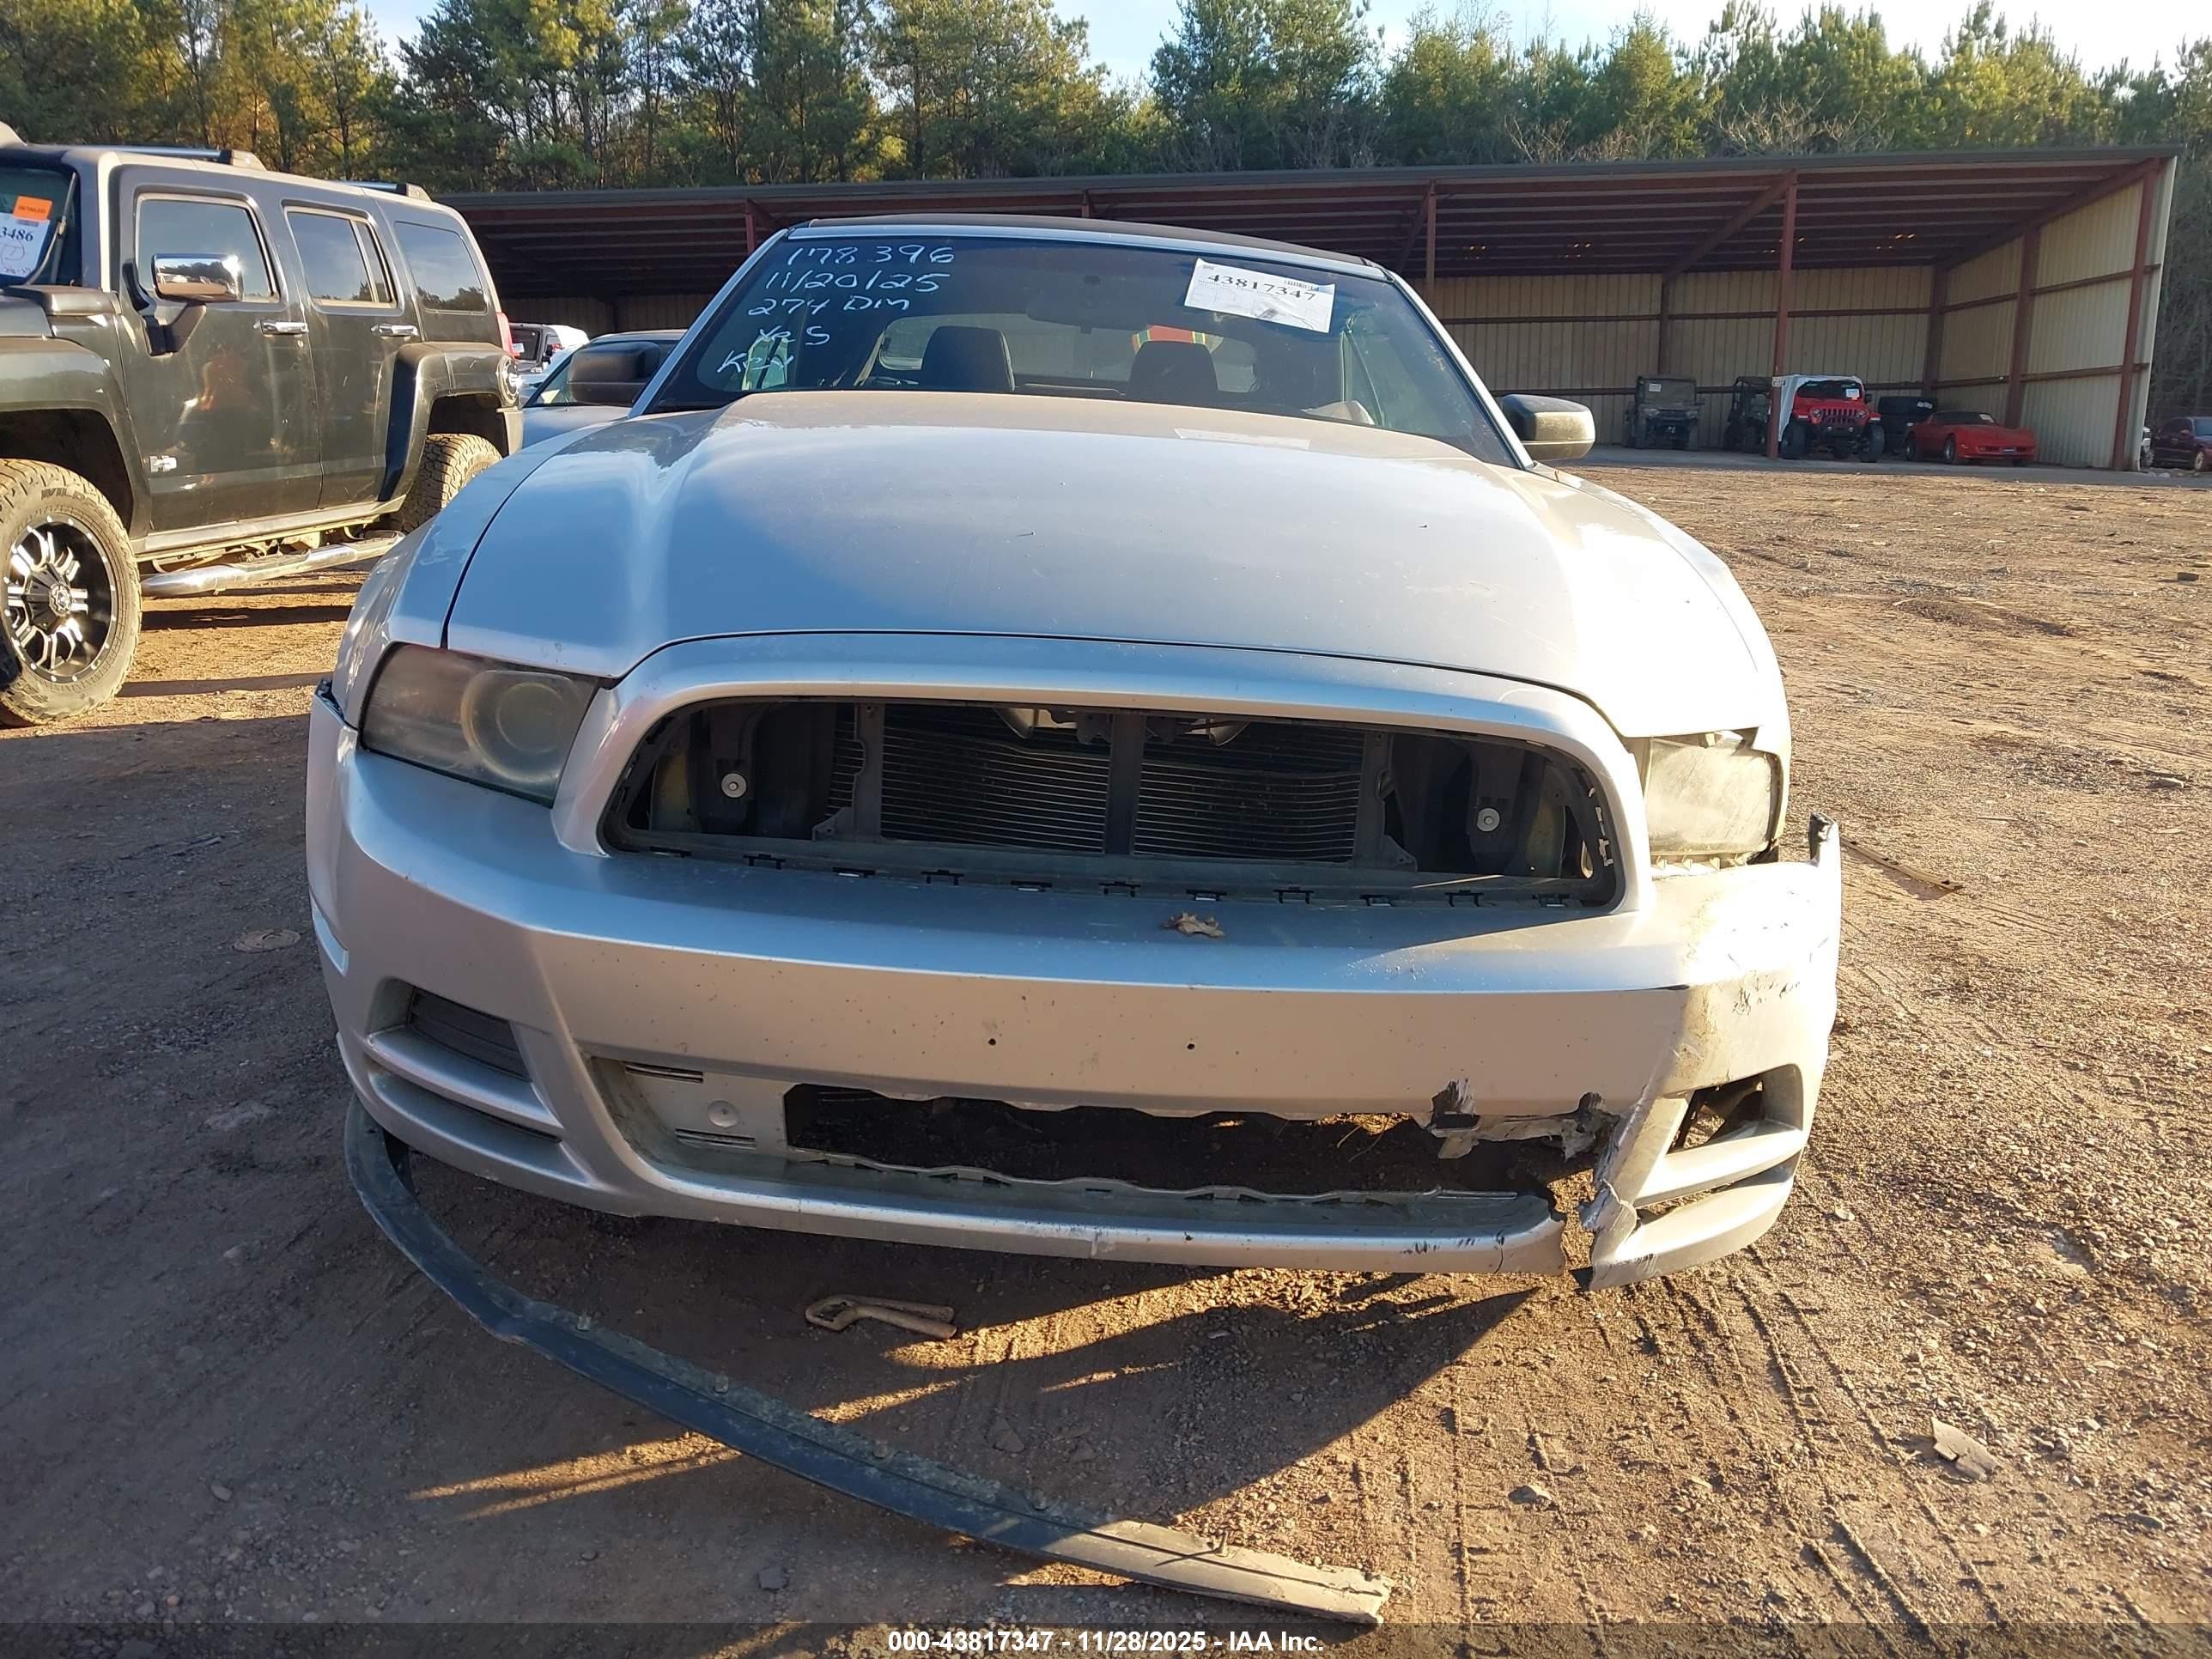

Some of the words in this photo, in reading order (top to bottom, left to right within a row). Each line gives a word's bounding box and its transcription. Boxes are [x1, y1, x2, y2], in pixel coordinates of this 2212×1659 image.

[787, 247, 859, 265] 178
[869, 245, 955, 264] 396
[766, 270, 951, 293] 11/20/25
[1207, 274, 1316, 301] 43817347
[748, 298, 830, 316] 274
